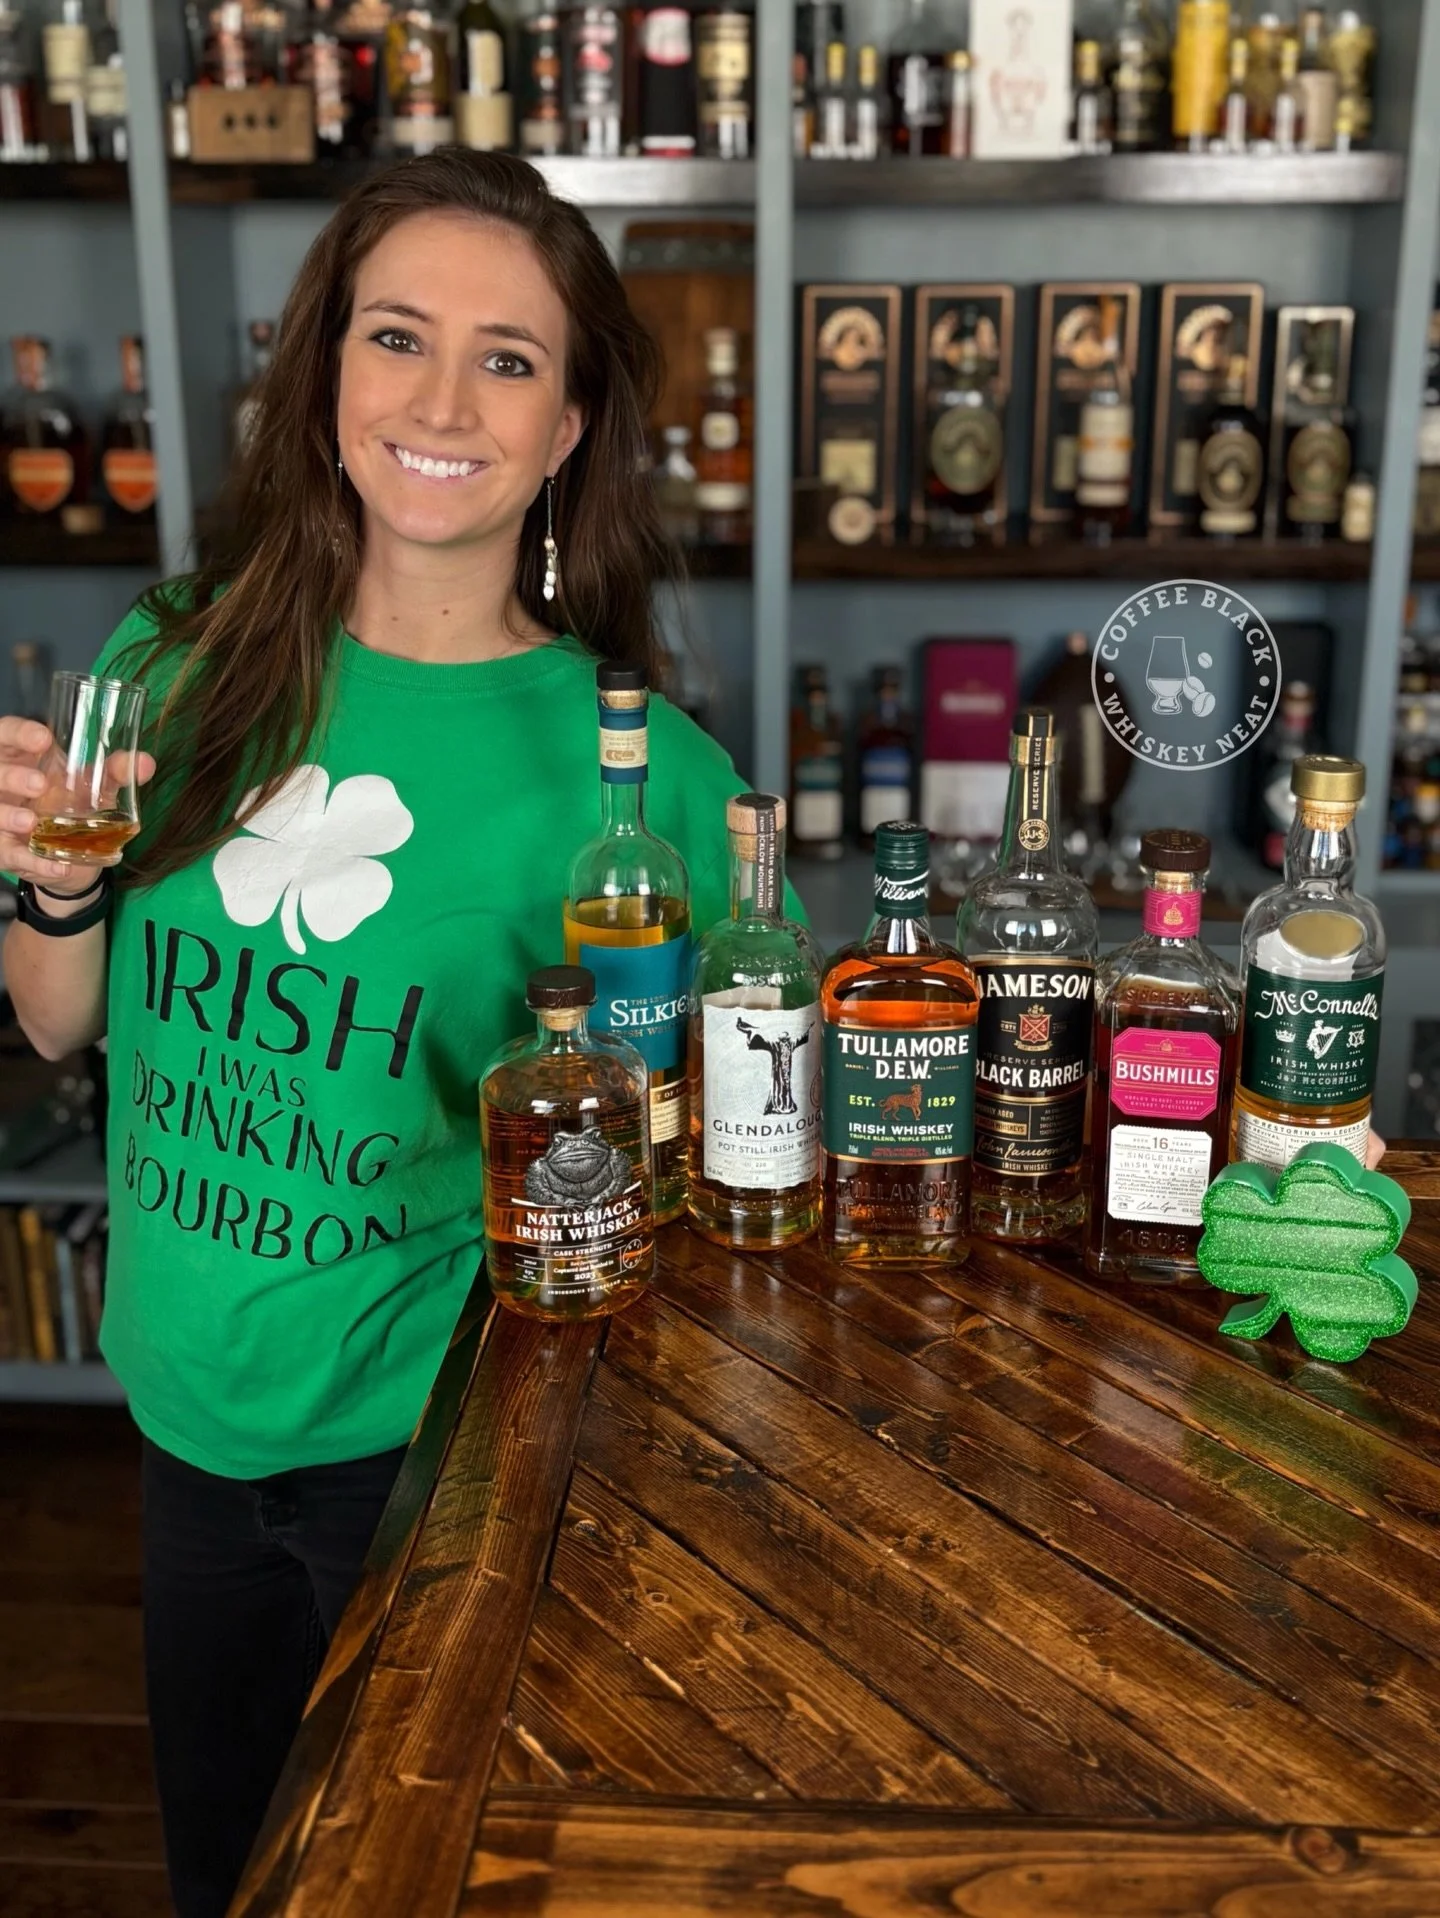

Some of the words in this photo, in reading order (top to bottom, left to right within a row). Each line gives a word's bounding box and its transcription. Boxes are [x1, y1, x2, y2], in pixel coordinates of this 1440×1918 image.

[1032, 770, 1040, 810] RESERVE
[757, 865, 765, 909] MOUNTAINS
[977, 974, 1091, 1000] JAMESON
[145, 919, 424, 1079] IRISH
[610, 994, 688, 1027] SILKIE
[837, 1033, 969, 1057] TULLAMORE
[875, 1059, 932, 1079] D.E.W.
[987, 1053, 1036, 1066] RESERVE
[1270, 1056, 1308, 1069] IRISH
[1316, 1058, 1365, 1070] WHISKY
[198, 1046, 207, 1077] I
[220, 1053, 307, 1107] WAS
[976, 1058, 1024, 1087] BLACK
[1029, 1060, 1084, 1088] BARREL
[1116, 1060, 1215, 1086] BUSHMILLS
[849, 1095, 876, 1107] EST.
[927, 1096, 956, 1108] 1829
[132, 1049, 400, 1187] DRINKING
[713, 1110, 821, 1137] GLENDALOUG
[998, 1110, 1014, 1119] AGED
[849, 1122, 885, 1135] IRISH
[891, 1123, 954, 1136] WHISKEY
[849, 1132, 871, 1141] TRIPLE
[921, 1134, 953, 1142] DISTILLED
[1252, 1127, 1280, 1140] REVIVAL
[1262, 1121, 1317, 1137] RESTORING
[1333, 1124, 1361, 1136] LEGEND
[718, 1141, 735, 1152] POT
[739, 1143, 766, 1154] STILL
[769, 1142, 794, 1153] IRISH
[1152, 1136, 1169, 1150] 16
[1002, 1162, 1021, 1171] IRISH
[1023, 1163, 1053, 1171] WHISKEY
[1120, 1161, 1148, 1169] IRISH
[1153, 1163, 1200, 1175] WHISKEY
[1127, 1152, 1164, 1161] SINGLE
[1167, 1156, 1195, 1165] MALT
[125, 1129, 407, 1266] BOURBON
[526, 1197, 633, 1227] NATTERJACK
[516, 1224, 563, 1241] IRISH
[568, 1207, 642, 1242] WHISKEY
[575, 1243, 613, 1256] STRENGTH
